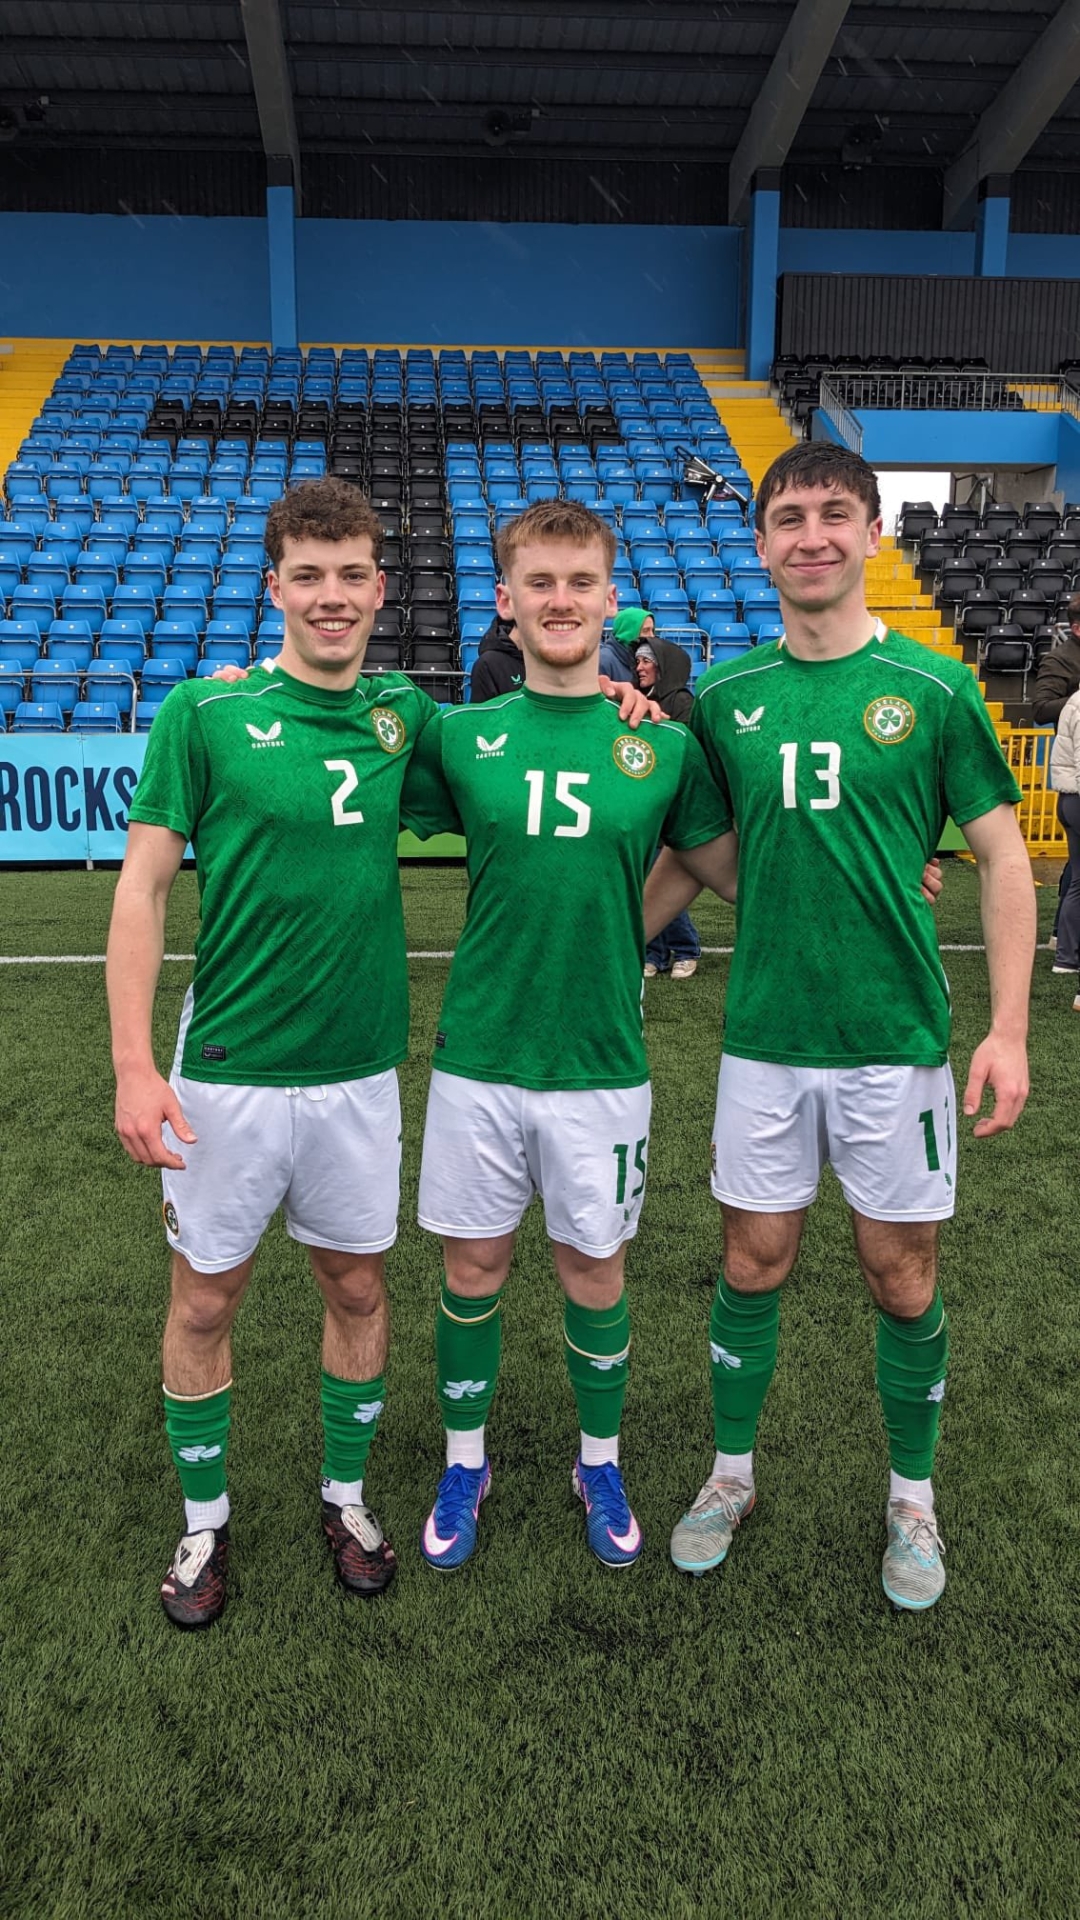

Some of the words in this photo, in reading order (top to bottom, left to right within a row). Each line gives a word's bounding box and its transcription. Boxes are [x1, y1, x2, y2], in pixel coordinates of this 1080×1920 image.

[871, 699, 911, 716] IRELAND
[0, 761, 138, 832] ROCKS
[323, 759, 364, 826] 2
[524, 769, 592, 838] 15
[779, 741, 842, 810] 13
[612, 1135, 647, 1205] 15
